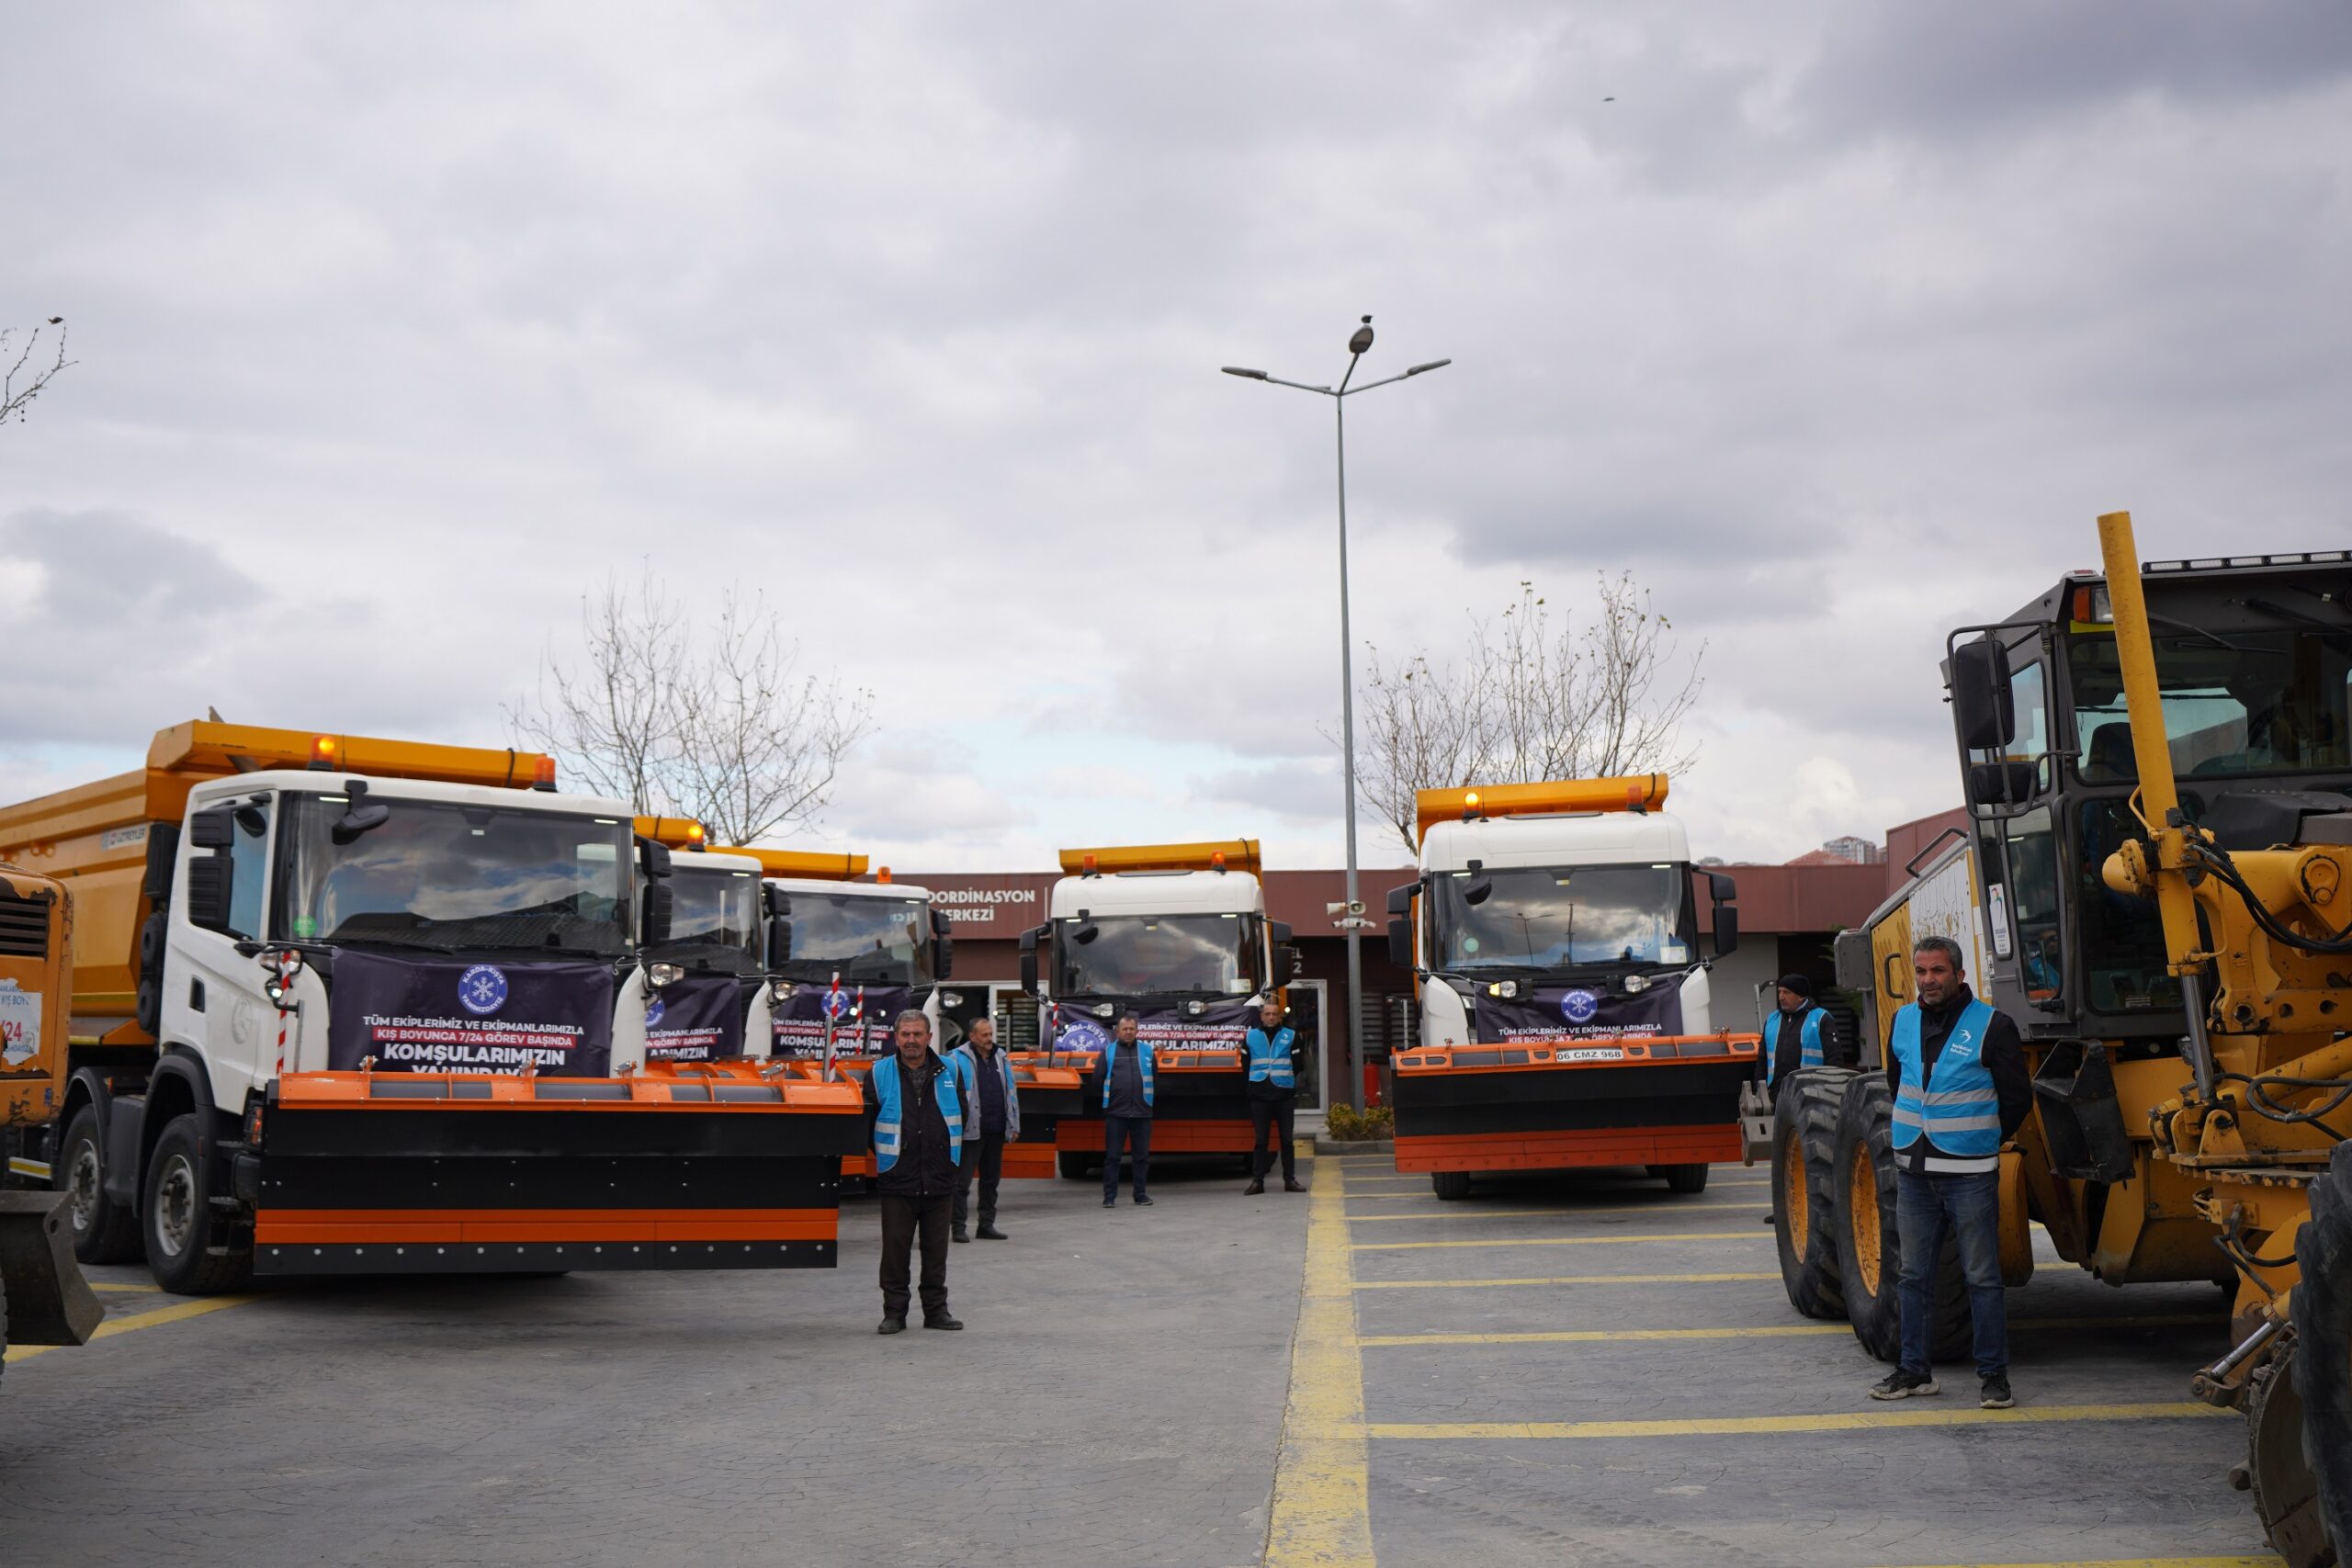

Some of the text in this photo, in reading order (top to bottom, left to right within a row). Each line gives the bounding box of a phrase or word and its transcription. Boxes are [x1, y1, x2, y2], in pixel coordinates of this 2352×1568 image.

[927, 886, 1035, 904] OORDİNASYON
[940, 905, 994, 921] ERKEZİ
[363, 1014, 584, 1035] TÜM EKİPLERİMİZ VE EKİPMANLARIMIZLA
[772, 1017, 785, 1026] ÜM
[1137, 1022, 1171, 1031] İPLERİMİZ
[650, 1028, 722, 1039] EKİPMANLARIMIZLA
[1186, 1030, 1211, 1039] GÖREV
[1498, 1027, 1516, 1036] TÜM
[1519, 1025, 1567, 1035] EKİPLERİMİZ
[1582, 1023, 1662, 1034] EKİPMANLARIMIZLA
[378, 1029, 572, 1047] KIŞ BOYUNCA 7/24 GÖREV BAŞINDA
[653, 1038, 681, 1047] GÖREV
[684, 1036, 713, 1046] BAŞINDA
[384, 1043, 565, 1066] KOMŞULARIMIZIN
[1557, 1053, 1571, 1061] 06
[1574, 1051, 1598, 1059] CMZ
